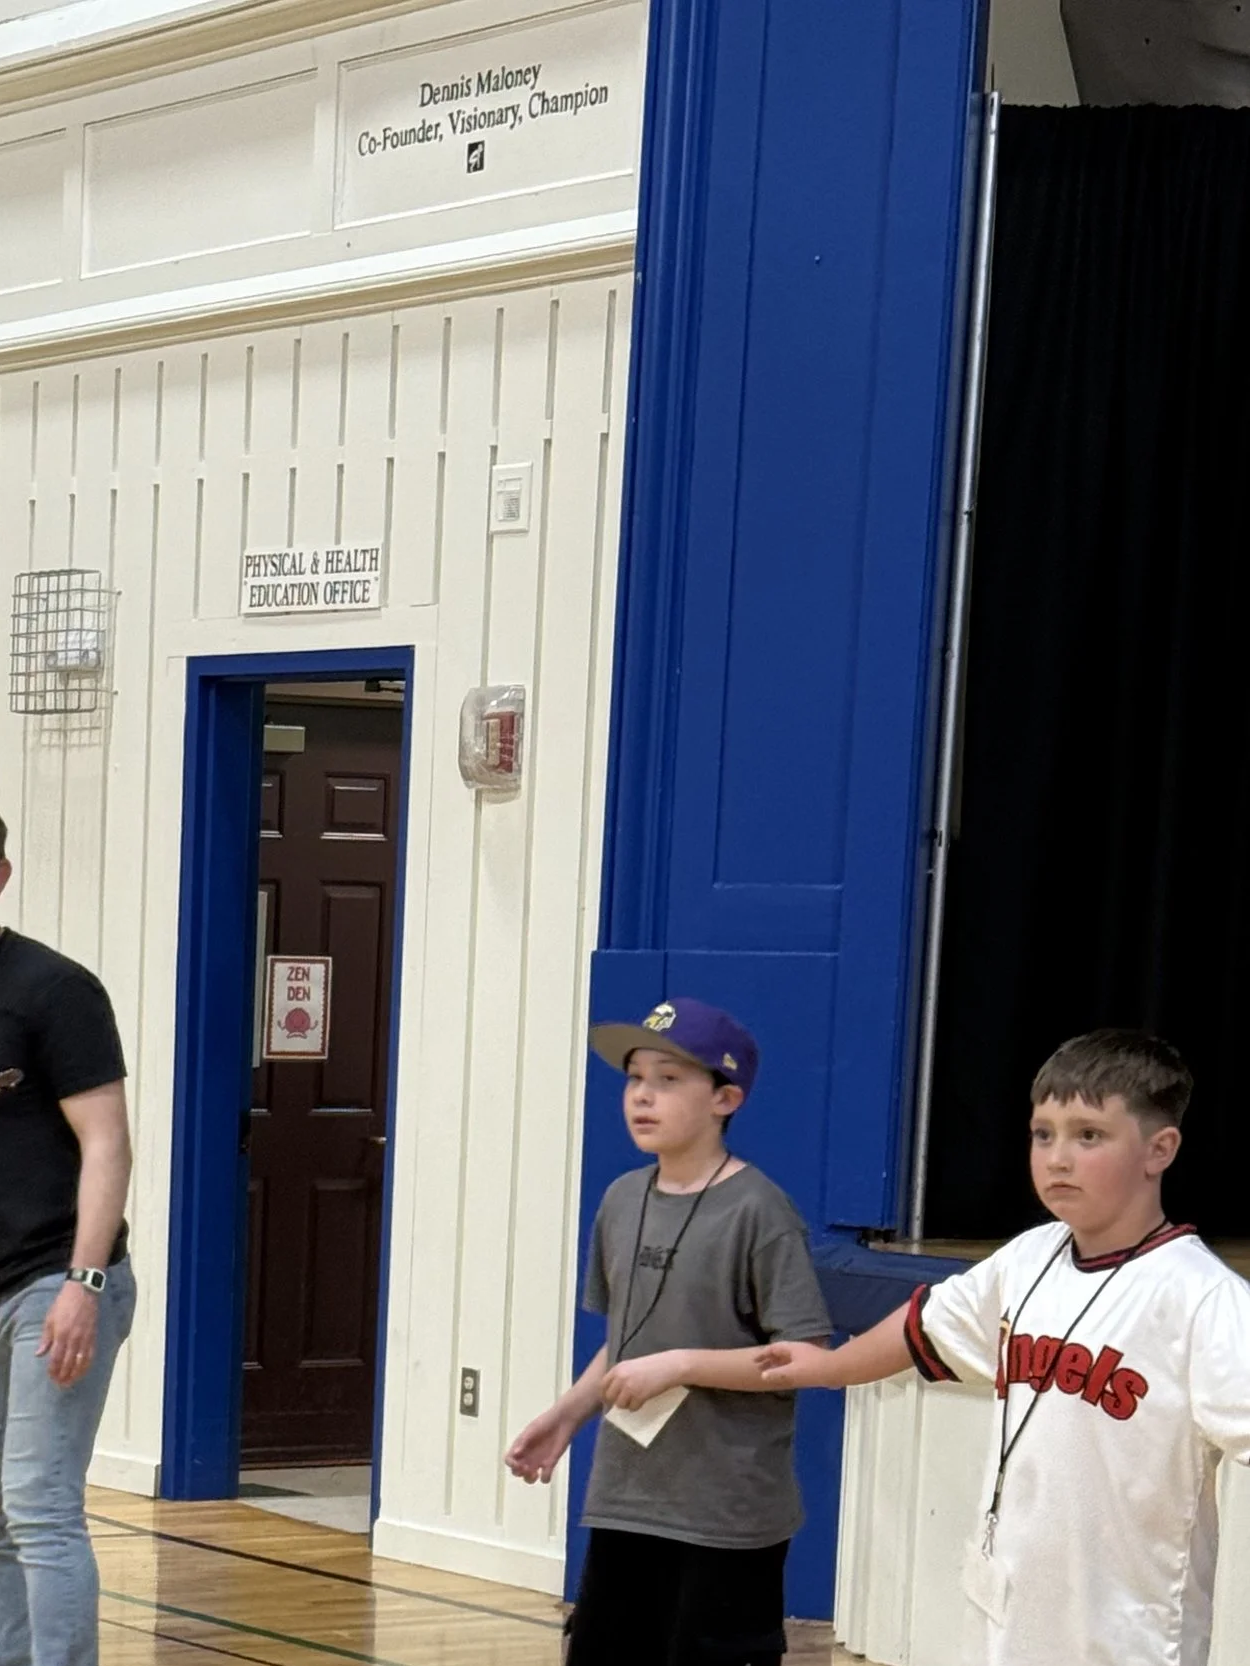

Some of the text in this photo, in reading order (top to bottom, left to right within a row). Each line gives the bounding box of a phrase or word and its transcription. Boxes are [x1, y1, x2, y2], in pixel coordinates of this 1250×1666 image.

[418, 63, 543, 108] Dennis Maloney
[356, 82, 610, 157] Co-Founder, Visionary, Champion
[244, 547, 380, 578] PHYSICAL & HEALTH
[249, 579, 371, 609] EDUCATION OFFICE
[286, 966, 311, 982] ZEN
[286, 985, 311, 1002] DEN
